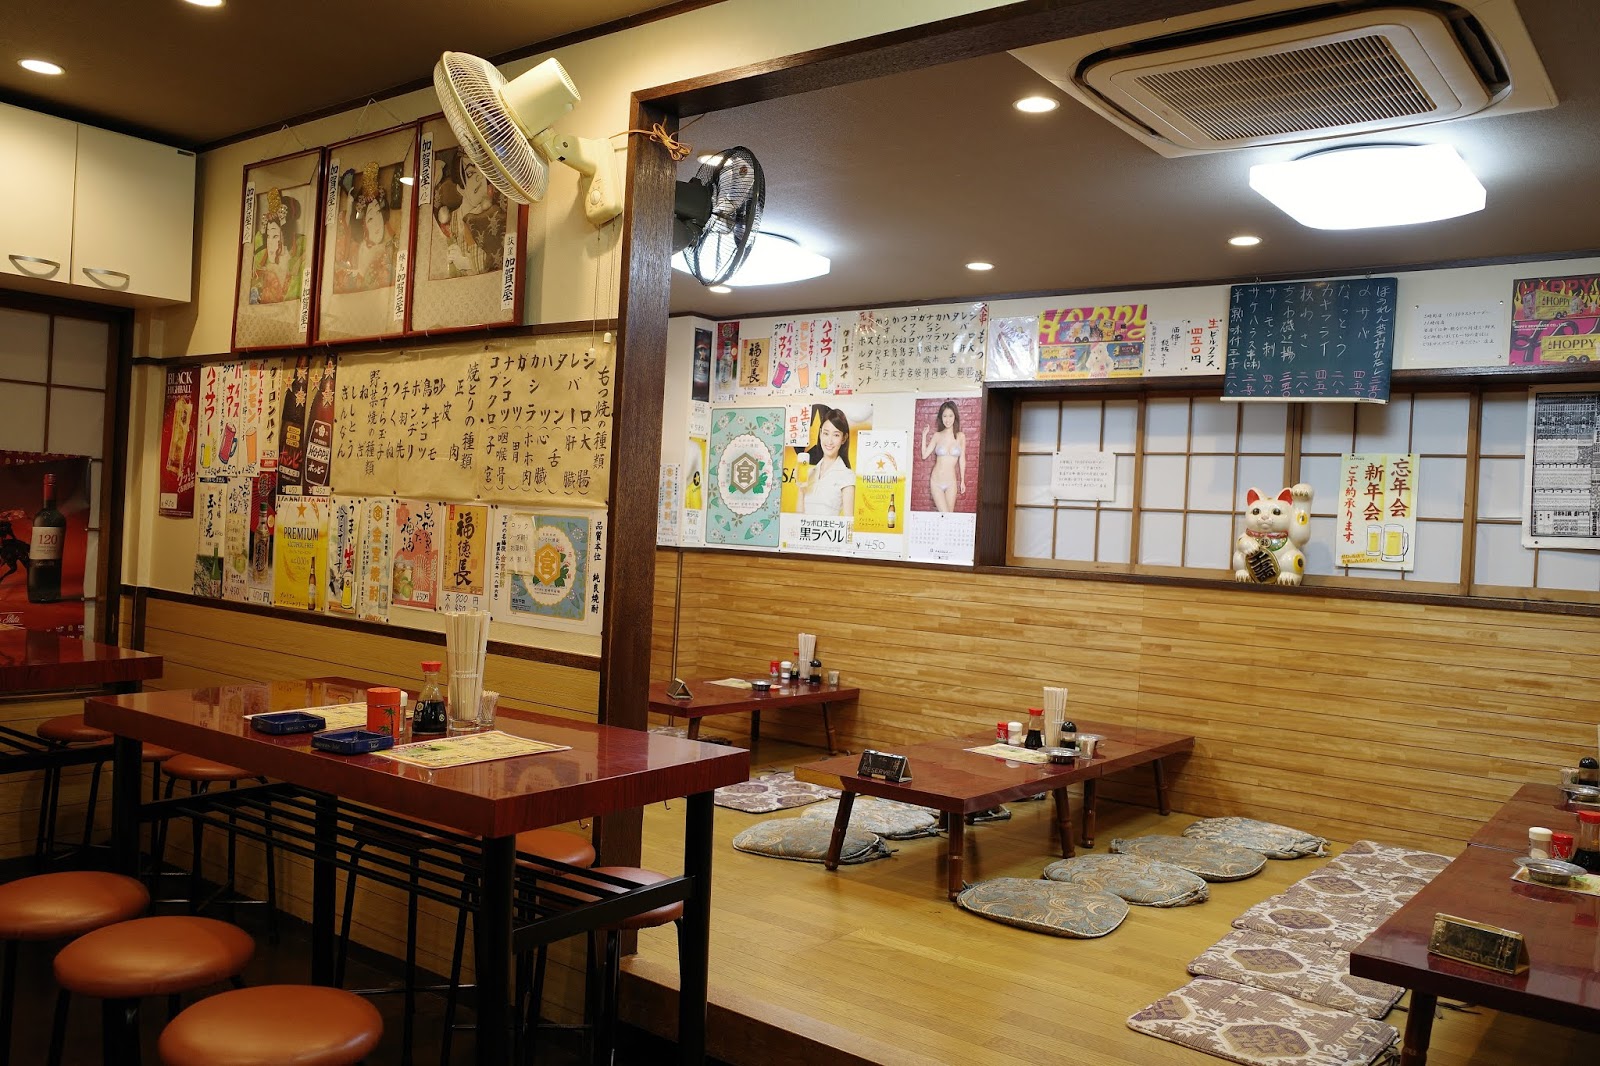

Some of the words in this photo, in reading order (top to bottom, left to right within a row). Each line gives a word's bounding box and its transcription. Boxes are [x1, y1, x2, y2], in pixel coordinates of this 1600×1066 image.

[502, 257, 516, 302] 加賀屋
[778, 336, 787, 358] サワー
[820, 320, 833, 368] ハイサワー
[1552, 338, 1596, 350] HOPPY
[167, 385, 192, 394] HIGHBALL
[168, 371, 192, 385] BLACK
[205, 367, 216, 436] ハイサワー
[337, 385, 349, 459] ぎんなん
[347, 386, 357, 459] ししとう
[356, 384, 369, 459] ねぎ
[365, 370, 381, 476] 野菜焼の種類
[376, 381, 390, 460] うずら玉子
[386, 382, 400, 459] つくね
[396, 381, 410, 460] 手羽先
[418, 378, 433, 460] 鳥ナンコツ
[428, 378, 446, 461] 砂ギモ
[460, 361, 480, 470] 焼とりの種類
[593, 366, 611, 470] もつ焼の種類
[308, 444, 329, 461] Hoppy
[865, 440, 901, 449] コク、ウマ。
[308, 462, 325, 474] ホッピー
[862, 475, 898, 485] PREMIUM
[1389, 458, 1412, 518] 忘年会
[1343, 465, 1359, 544] ご予約承ります。
[1363, 463, 1384, 521] 新年会
[205, 494, 216, 538] 玉乃光
[283, 526, 319, 541] PREMIUM
[799, 528, 845, 543] 黒ラベル
[800, 519, 845, 529] サッポロ生ビール
[38, 534, 58, 545] 120
[454, 511, 475, 586] 福徳長
[594, 521, 603, 561] 品質本位
[369, 527, 382, 602] 金宮焼酎
[473, 597, 478, 605] 円
[590, 573, 601, 614] 純良焼酎
[861, 766, 897, 776] RESERVED
